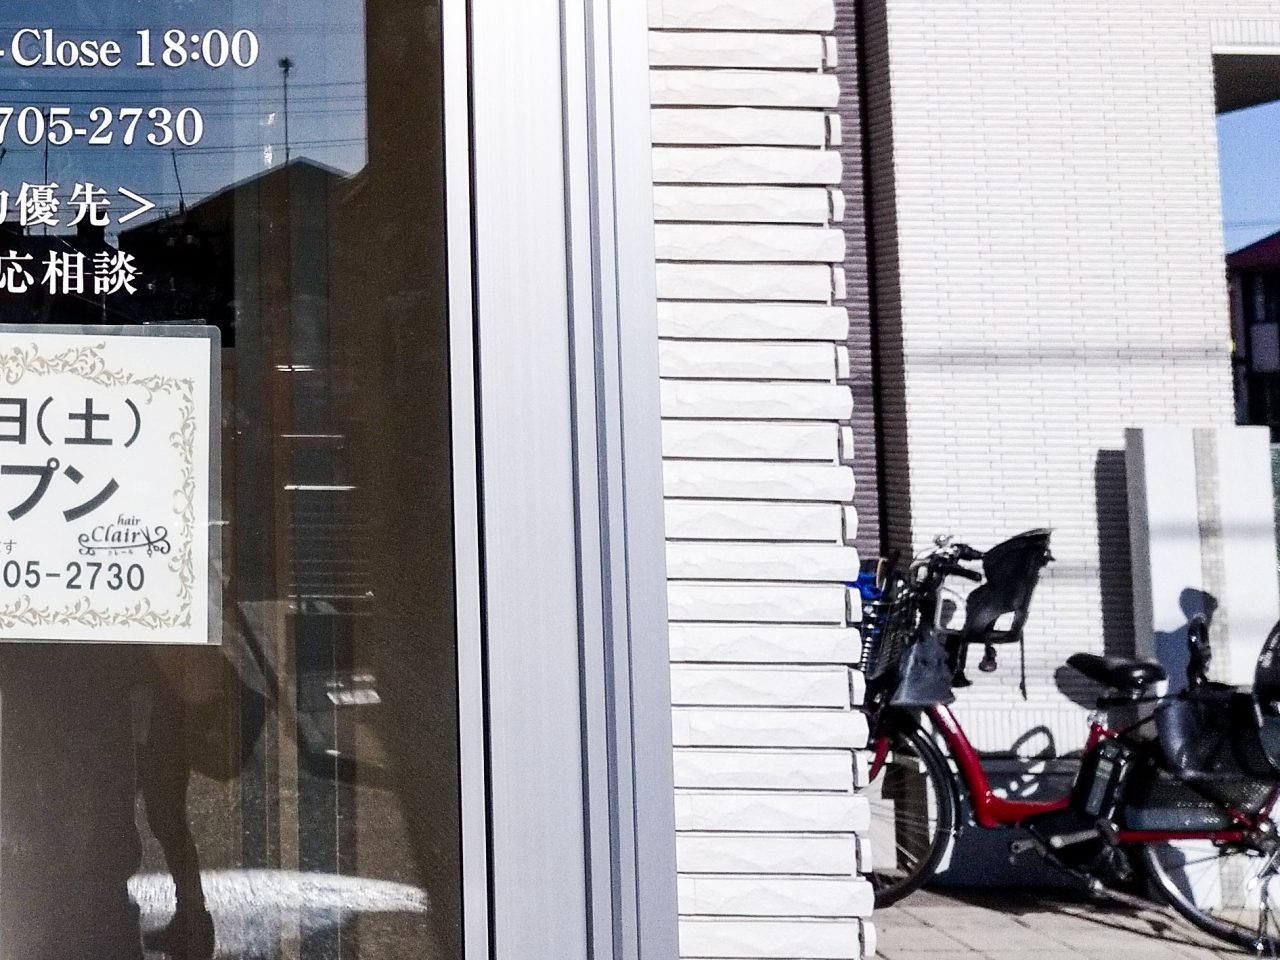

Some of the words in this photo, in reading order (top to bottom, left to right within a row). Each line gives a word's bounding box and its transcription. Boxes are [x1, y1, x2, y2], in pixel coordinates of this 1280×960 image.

[135, 29, 259, 68] 18:00
[117, 514, 141, 526] hair
[91, 524, 141, 543] Clair
